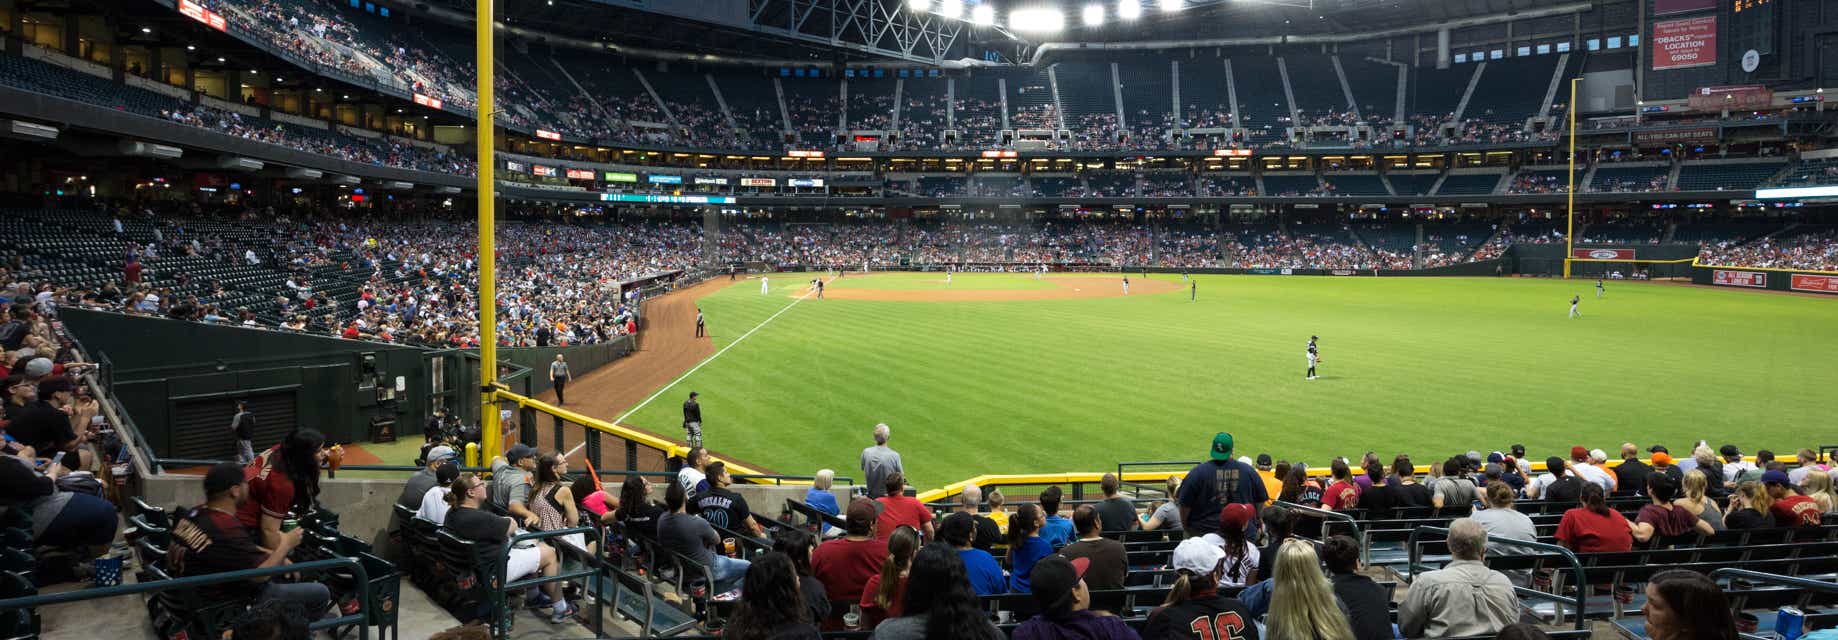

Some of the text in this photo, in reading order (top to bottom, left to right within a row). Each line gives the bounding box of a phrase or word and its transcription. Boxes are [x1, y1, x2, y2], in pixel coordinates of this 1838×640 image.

[1664, 40, 1705, 51] LOCATION
[1671, 53, 1698, 61] 69050
[1190, 610, 1246, 640] 16
